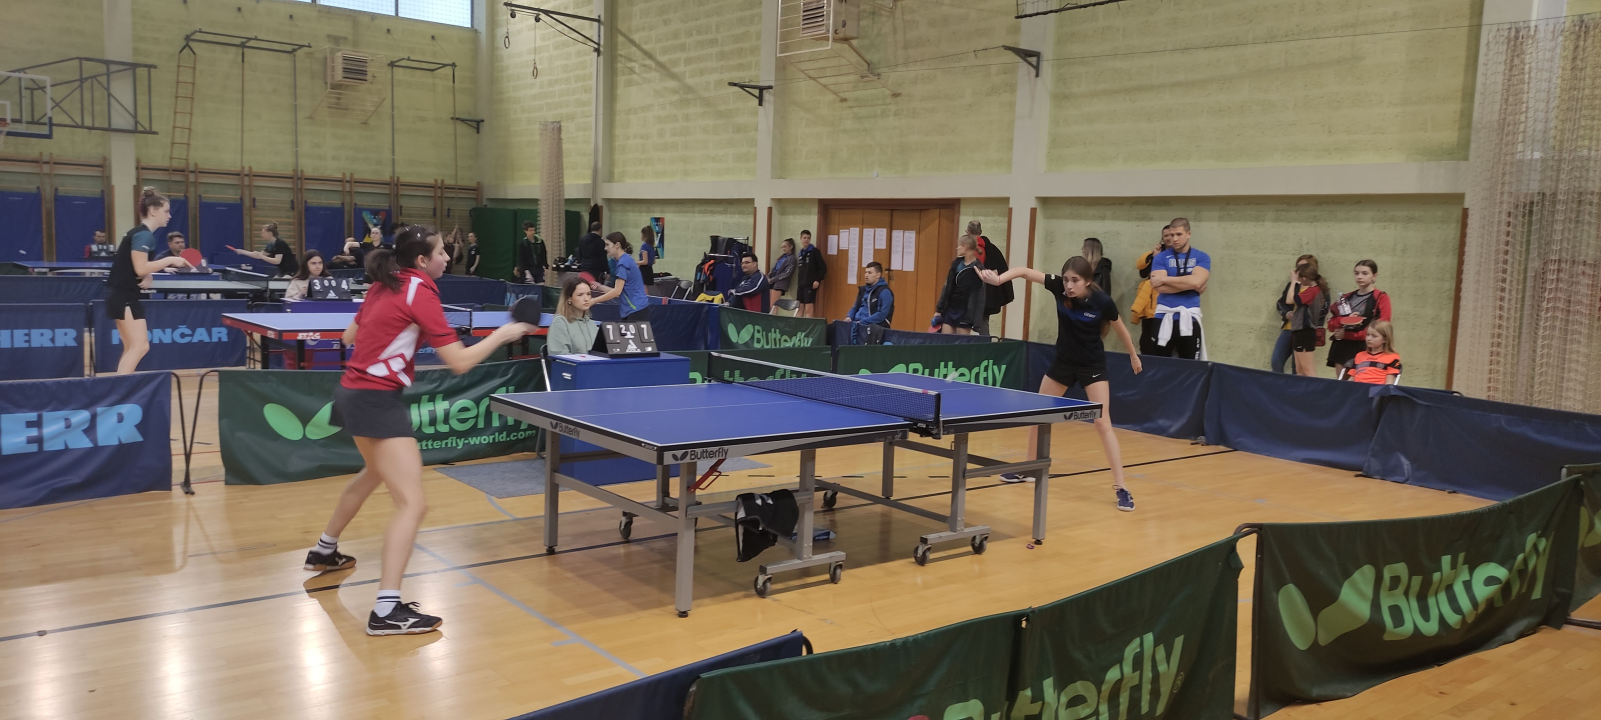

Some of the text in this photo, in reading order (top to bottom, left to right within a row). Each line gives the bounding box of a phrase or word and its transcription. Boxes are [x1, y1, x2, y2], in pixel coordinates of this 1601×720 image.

[313, 280, 320, 289] 3
[341, 280, 348, 289] 4
[112, 325, 228, 344] NČAR
[606, 325, 613, 340] 7
[641, 325, 648, 339] 7
[753, 325, 812, 348] Butterfly
[410, 386, 529, 433] tterf
[0, 403, 144, 455] ERR
[690, 448, 728, 460] Butterfly
[1380, 531, 1554, 641] Butterfy
[943, 632, 1185, 720] tterfly
